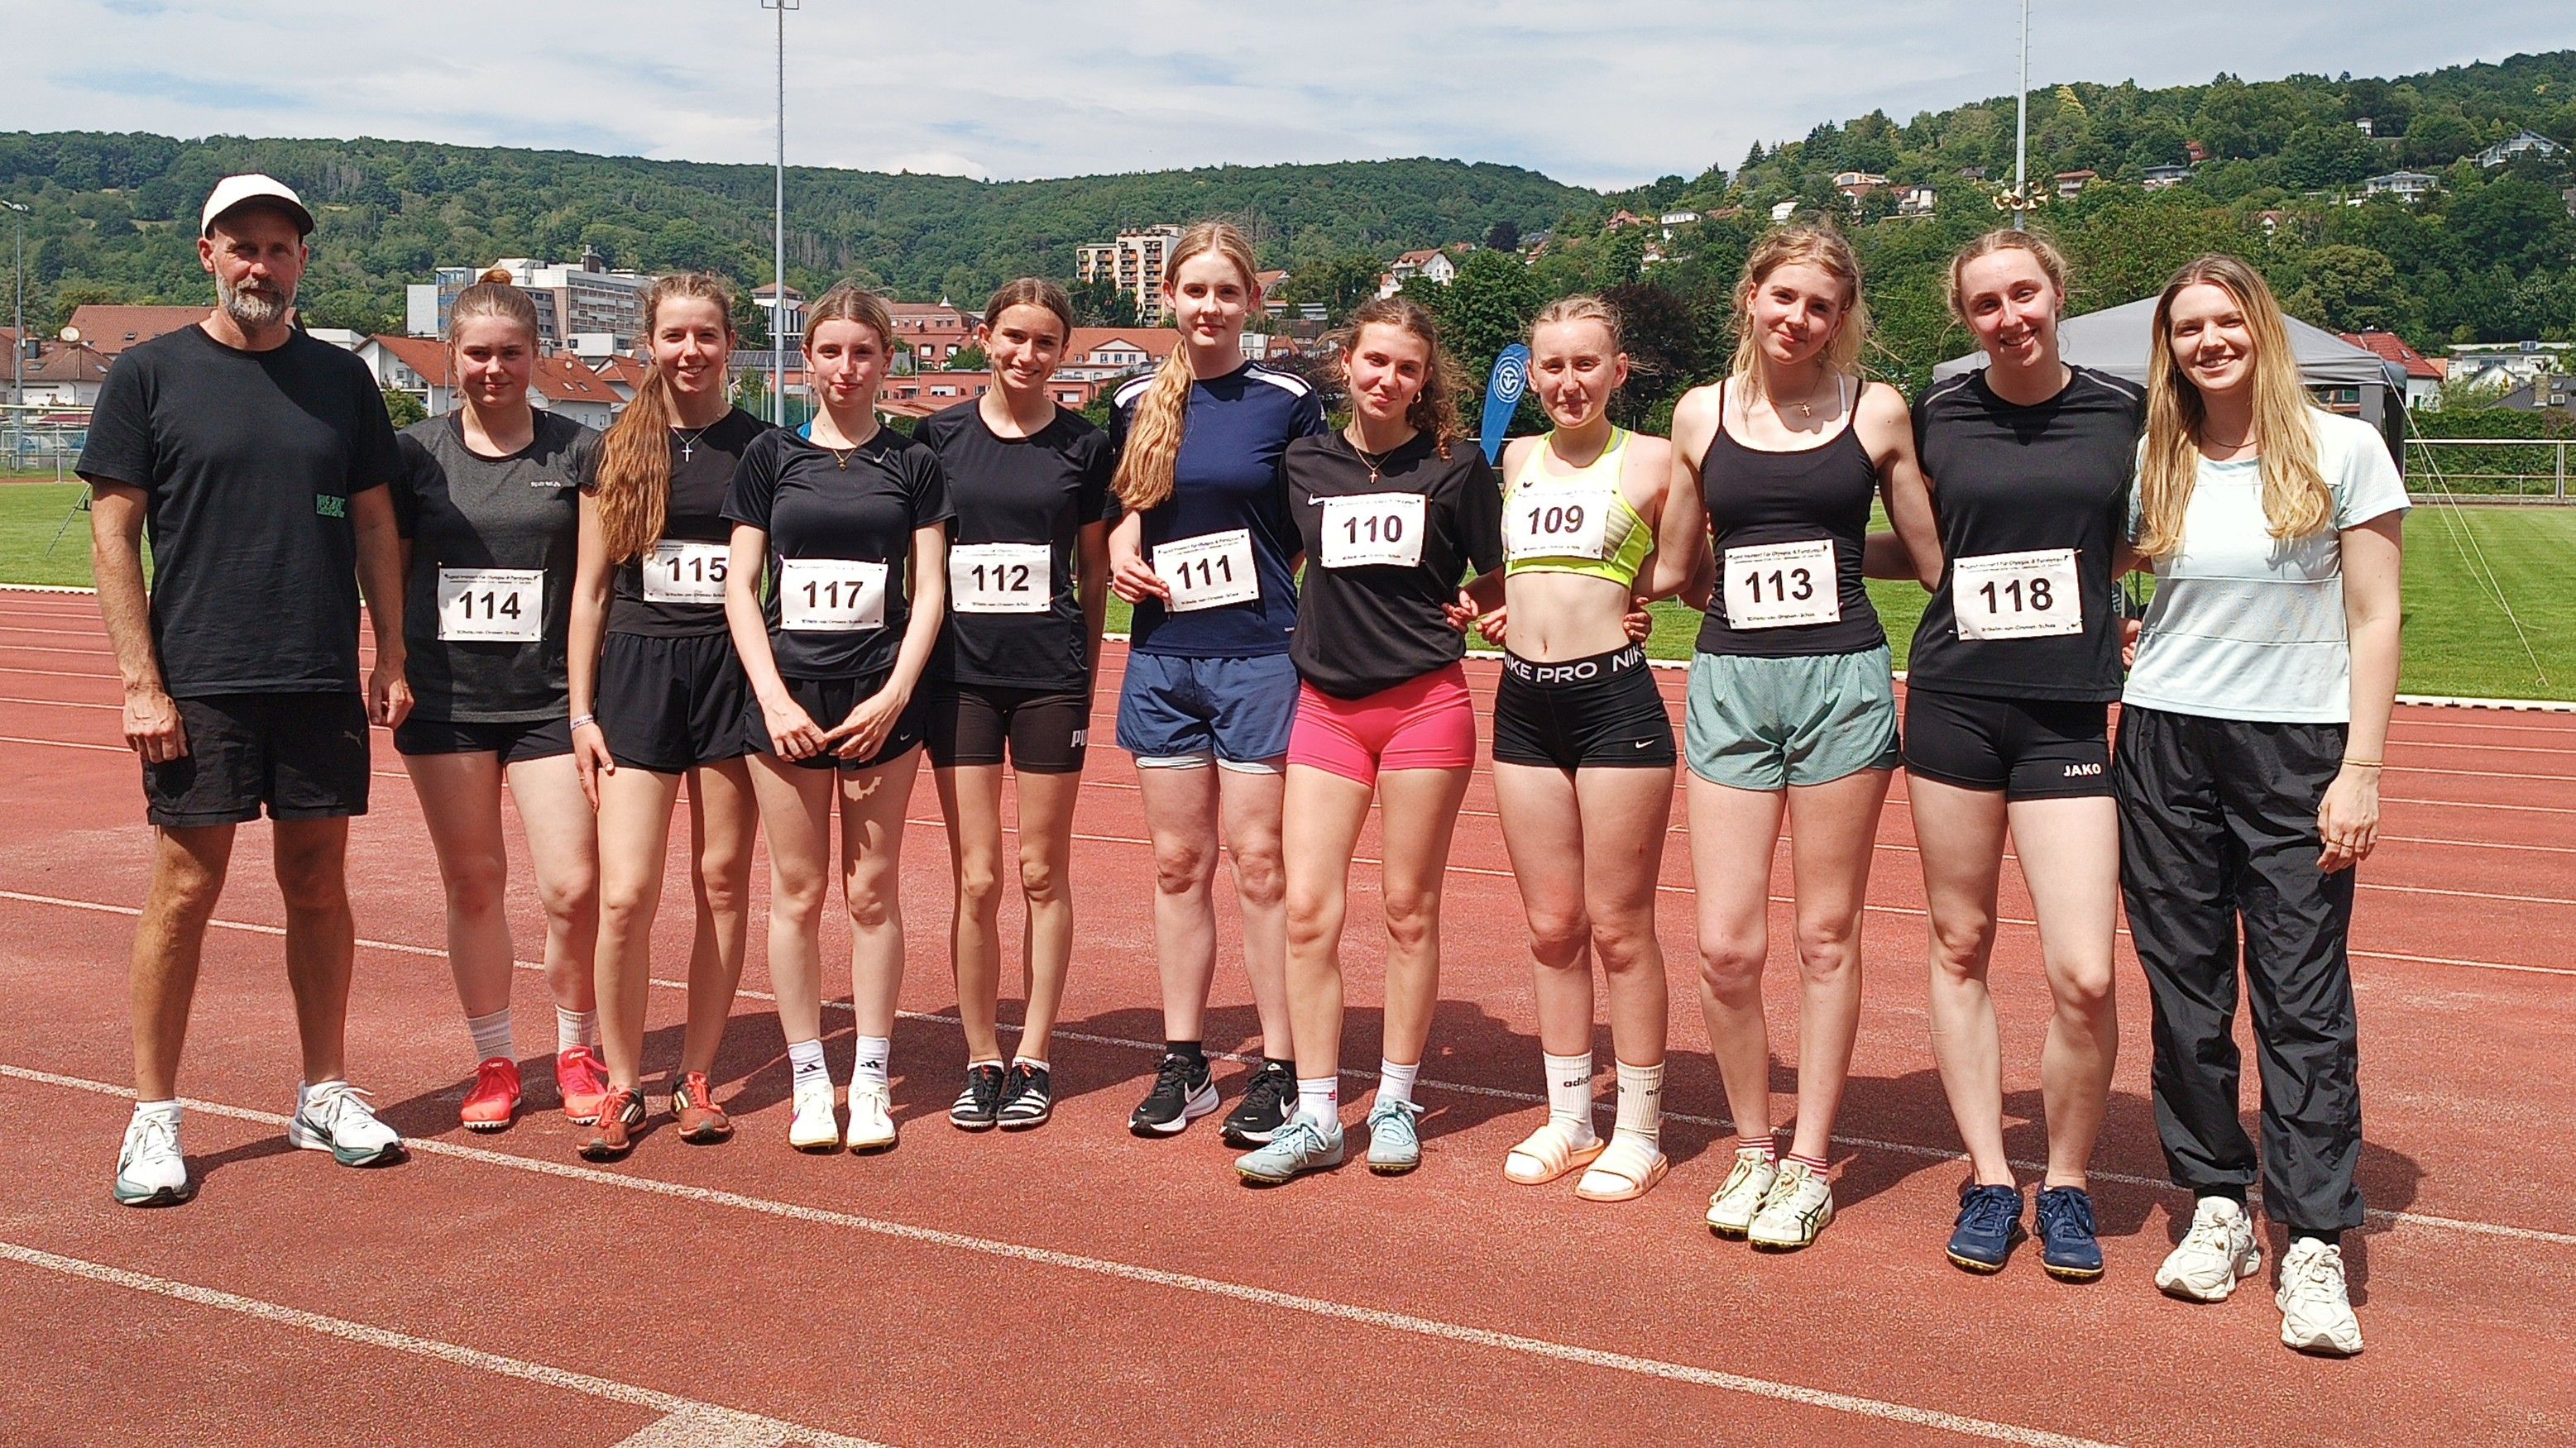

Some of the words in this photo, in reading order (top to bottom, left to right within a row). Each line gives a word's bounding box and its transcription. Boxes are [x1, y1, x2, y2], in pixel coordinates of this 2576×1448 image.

[1343, 514, 1402, 544] 110
[1527, 504, 1584, 535] 109
[667, 557, 728, 582] 115
[972, 564, 1029, 591] 112
[1176, 555, 1232, 590] 111
[802, 581, 864, 609] 117
[1745, 567, 1813, 603] 113
[1980, 577, 2053, 614] 118
[459, 591, 521, 619] 114
[1536, 662, 1597, 683] PRO
[1613, 643, 1643, 672] NIK
[2063, 763, 2101, 777] JAKO
